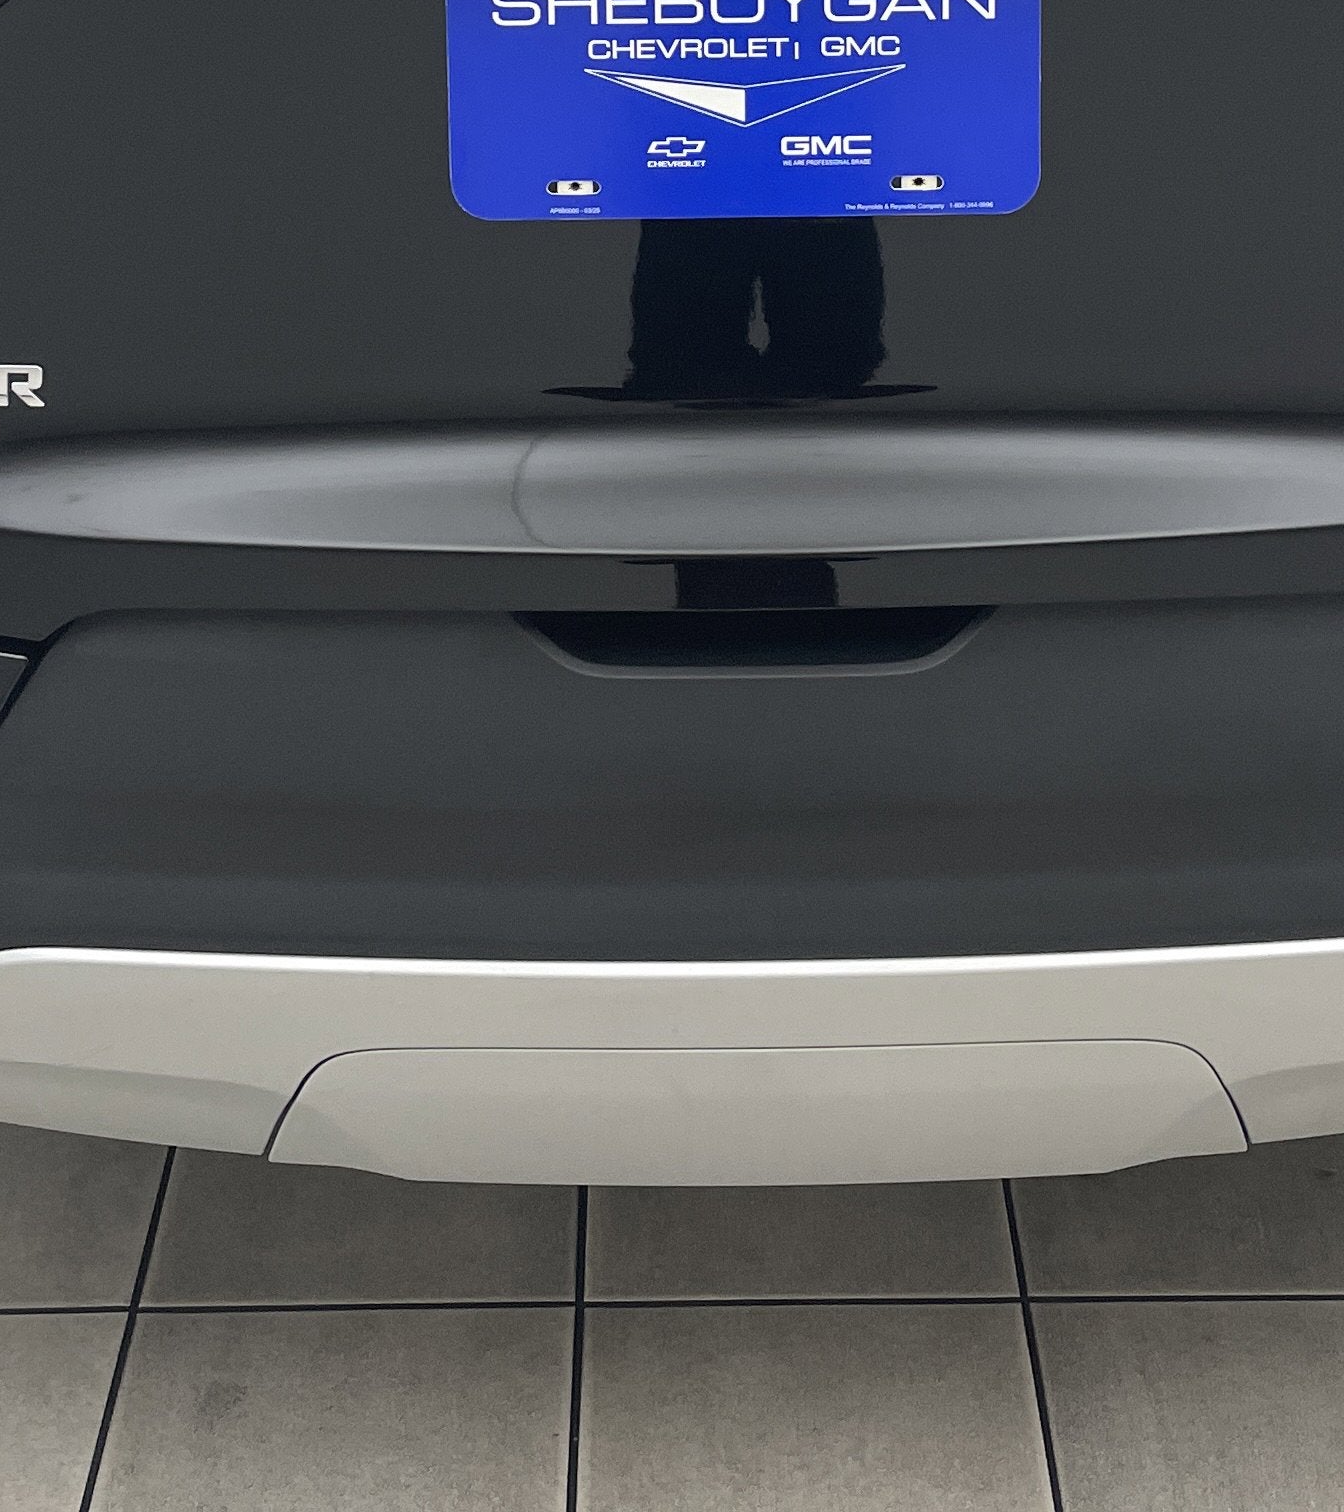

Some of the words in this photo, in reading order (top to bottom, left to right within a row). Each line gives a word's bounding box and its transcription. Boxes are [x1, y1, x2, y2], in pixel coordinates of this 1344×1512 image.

[587, 37, 789, 60] CHEVROLET
[820, 35, 901, 57] GMC
[780, 135, 872, 156] GMC
[647, 160, 706, 168] CHEVROLET
